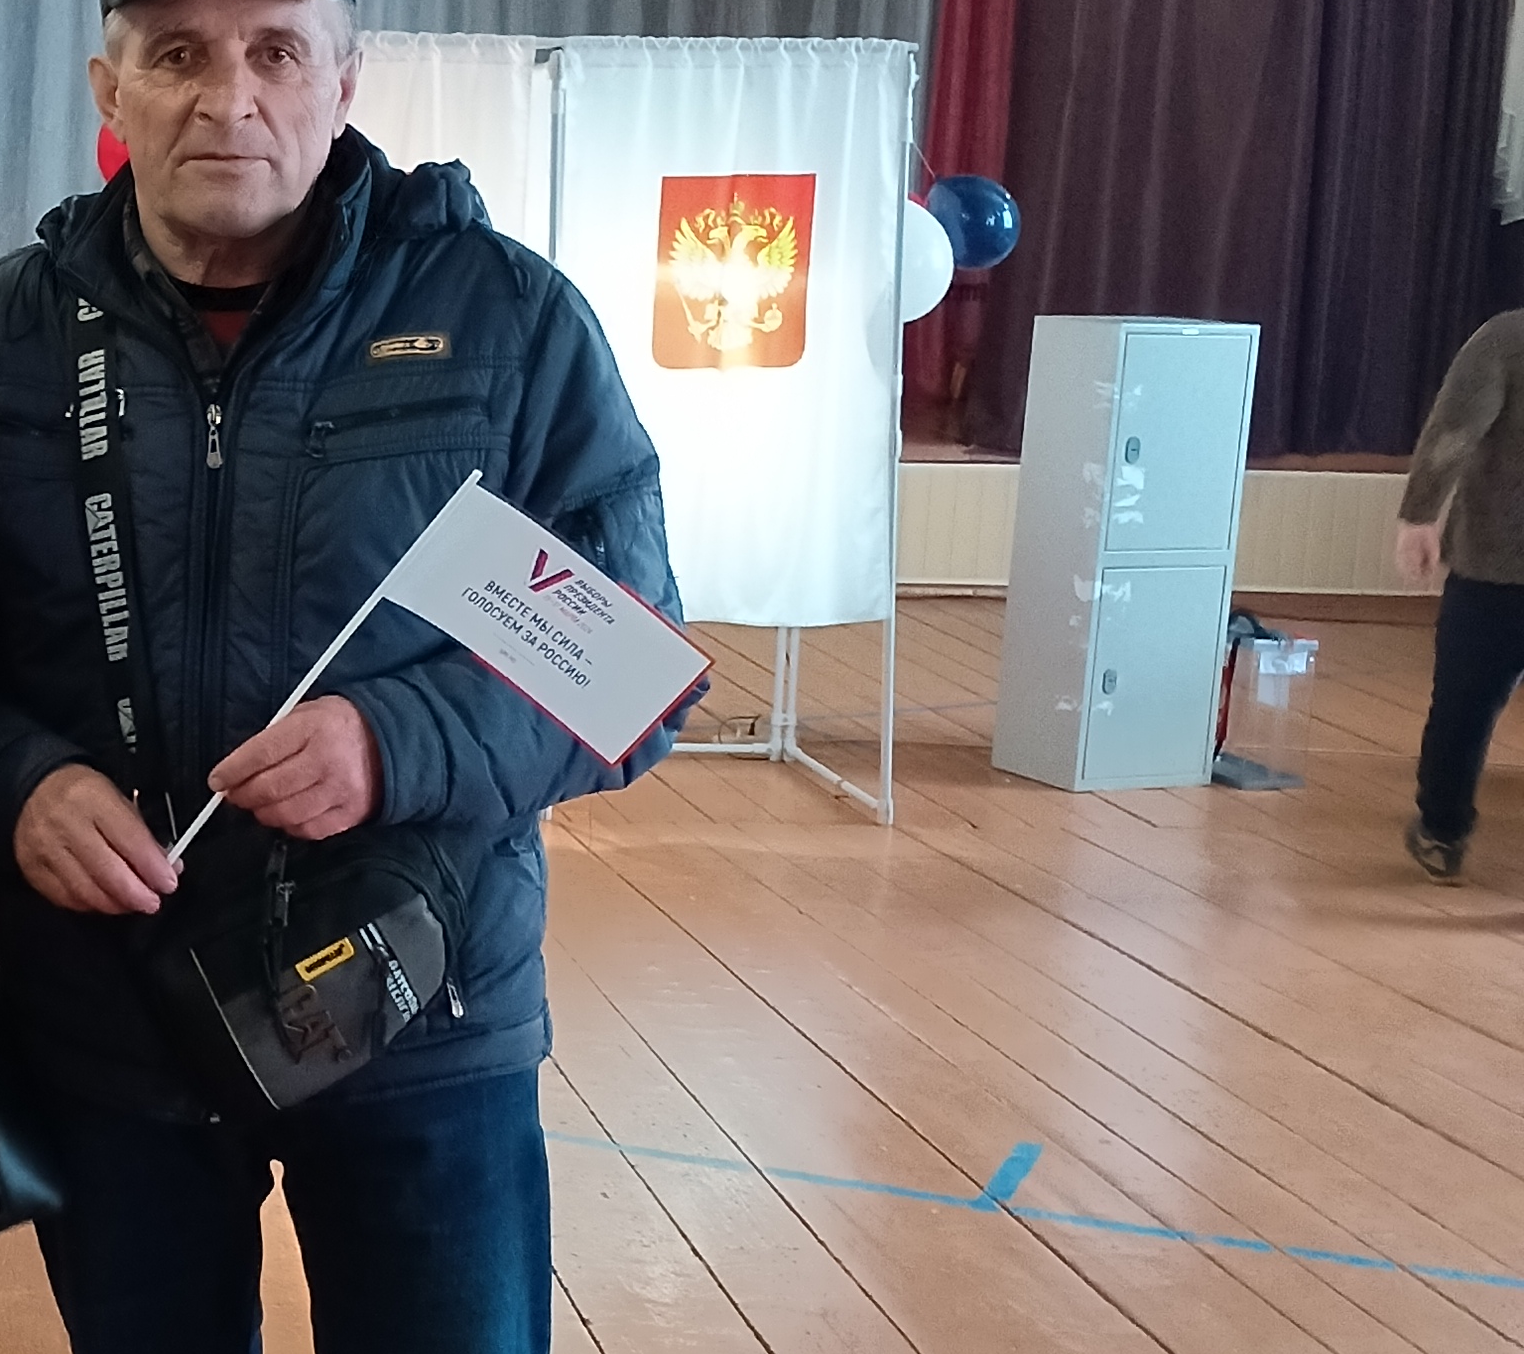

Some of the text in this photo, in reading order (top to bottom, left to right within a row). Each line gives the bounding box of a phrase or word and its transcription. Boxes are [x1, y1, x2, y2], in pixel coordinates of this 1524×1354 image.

[85, 492, 130, 662] CATERPILLAR
[552, 589, 587, 615] РОССИИ
[563, 584, 615, 625] ПРЕЗИДЕНТА
[575, 579, 613, 608] ВЫБОРЫ
[462, 587, 524, 635] ГОЛОСУЕМ
[520, 630, 538, 647] ЗА
[536, 642, 592, 689] РОССИЮ!
[484, 580, 532, 618] ВМЕСТЕ
[529, 612, 554, 635] МЫ
[551, 630, 585, 661] СИЛА
